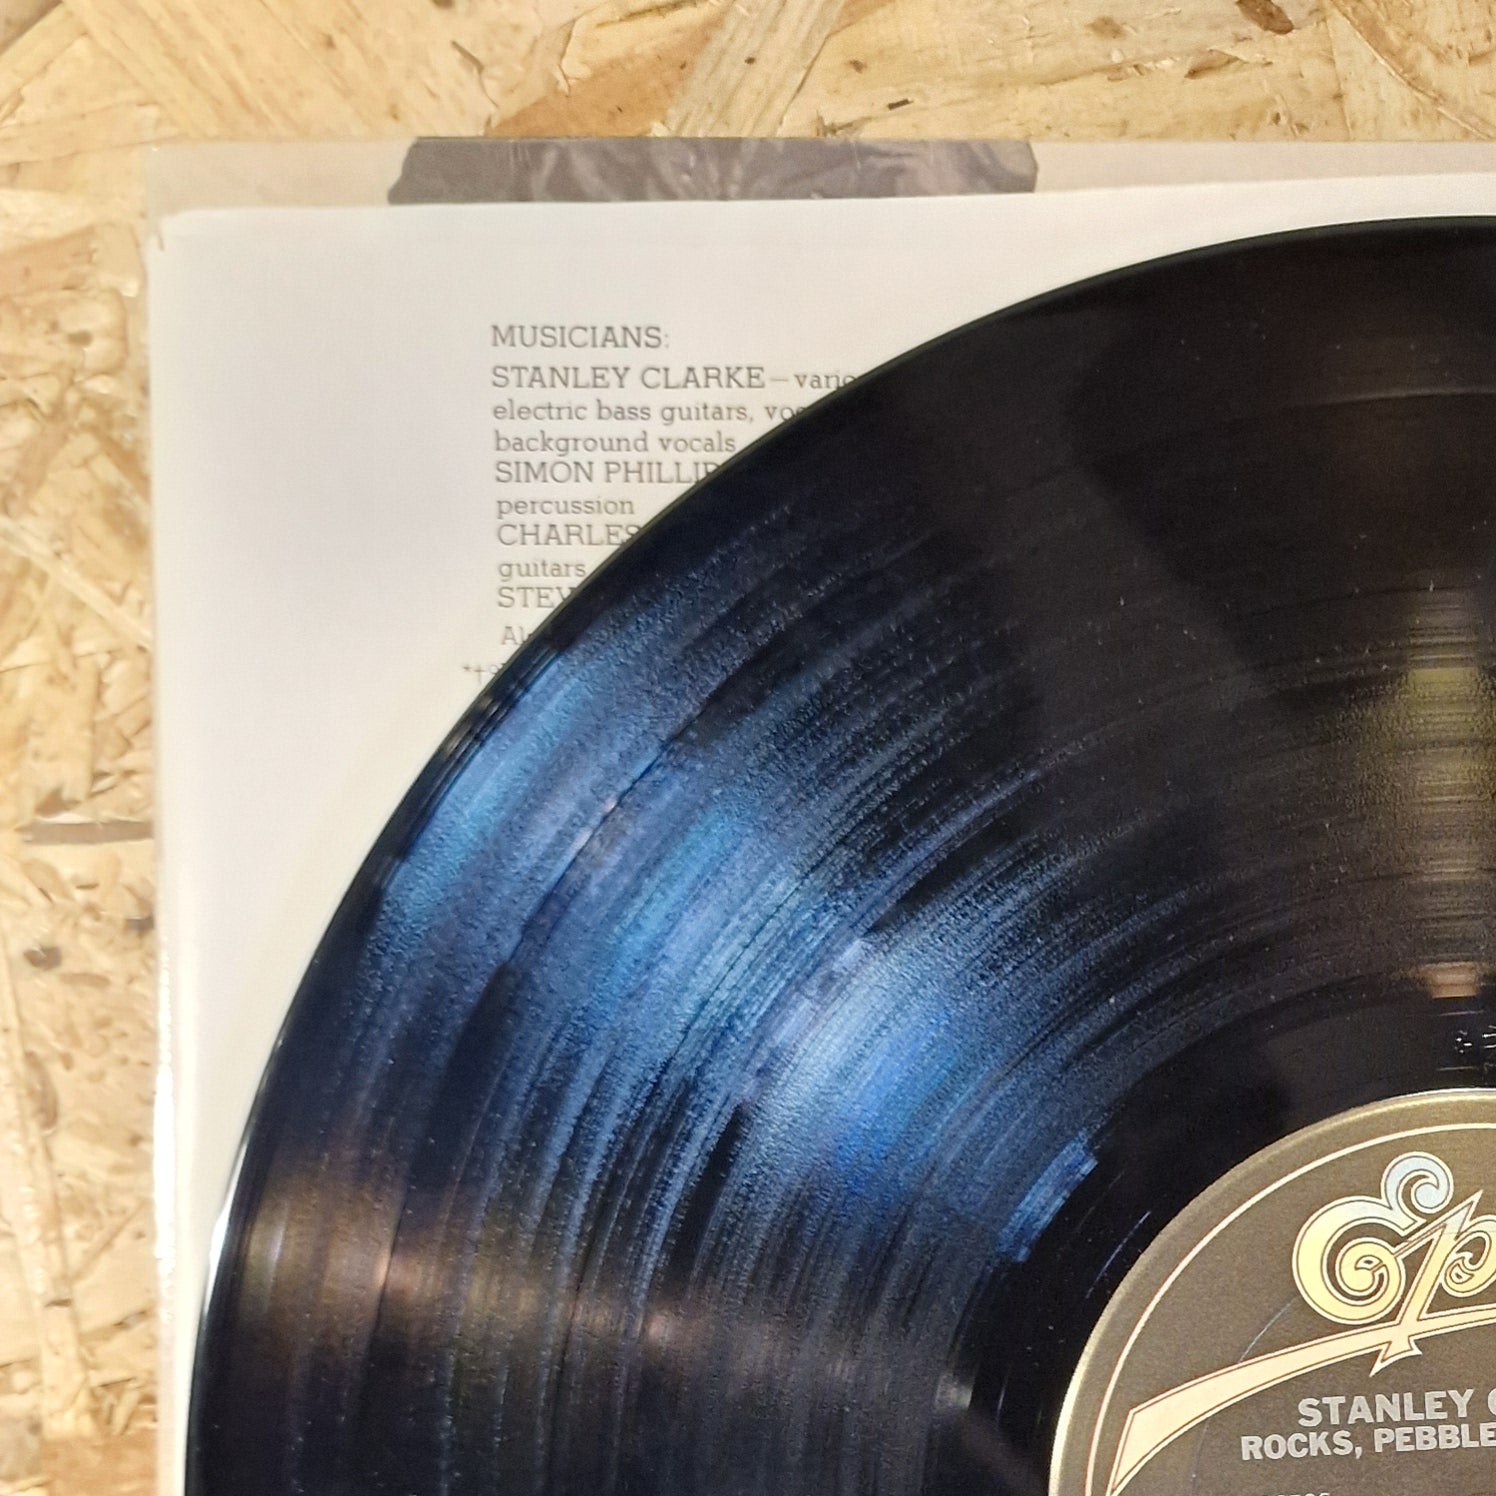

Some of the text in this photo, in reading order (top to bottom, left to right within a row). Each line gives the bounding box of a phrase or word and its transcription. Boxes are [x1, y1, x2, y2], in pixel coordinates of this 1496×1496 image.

[491, 325, 670, 349] MUSICIANS:
[491, 366, 630, 389] STANLEY
[493, 399, 586, 421] electric
[596, 399, 651, 421] bass
[661, 402, 754, 426] guitars,
[494, 430, 736, 457] background vocals
[496, 461, 594, 483] SIMON
[497, 496, 635, 520] percussion
[499, 559, 586, 582] guitars
[1298, 1389, 1474, 1427] STANLEY
[1241, 1430, 1362, 1460] ROCKS,
